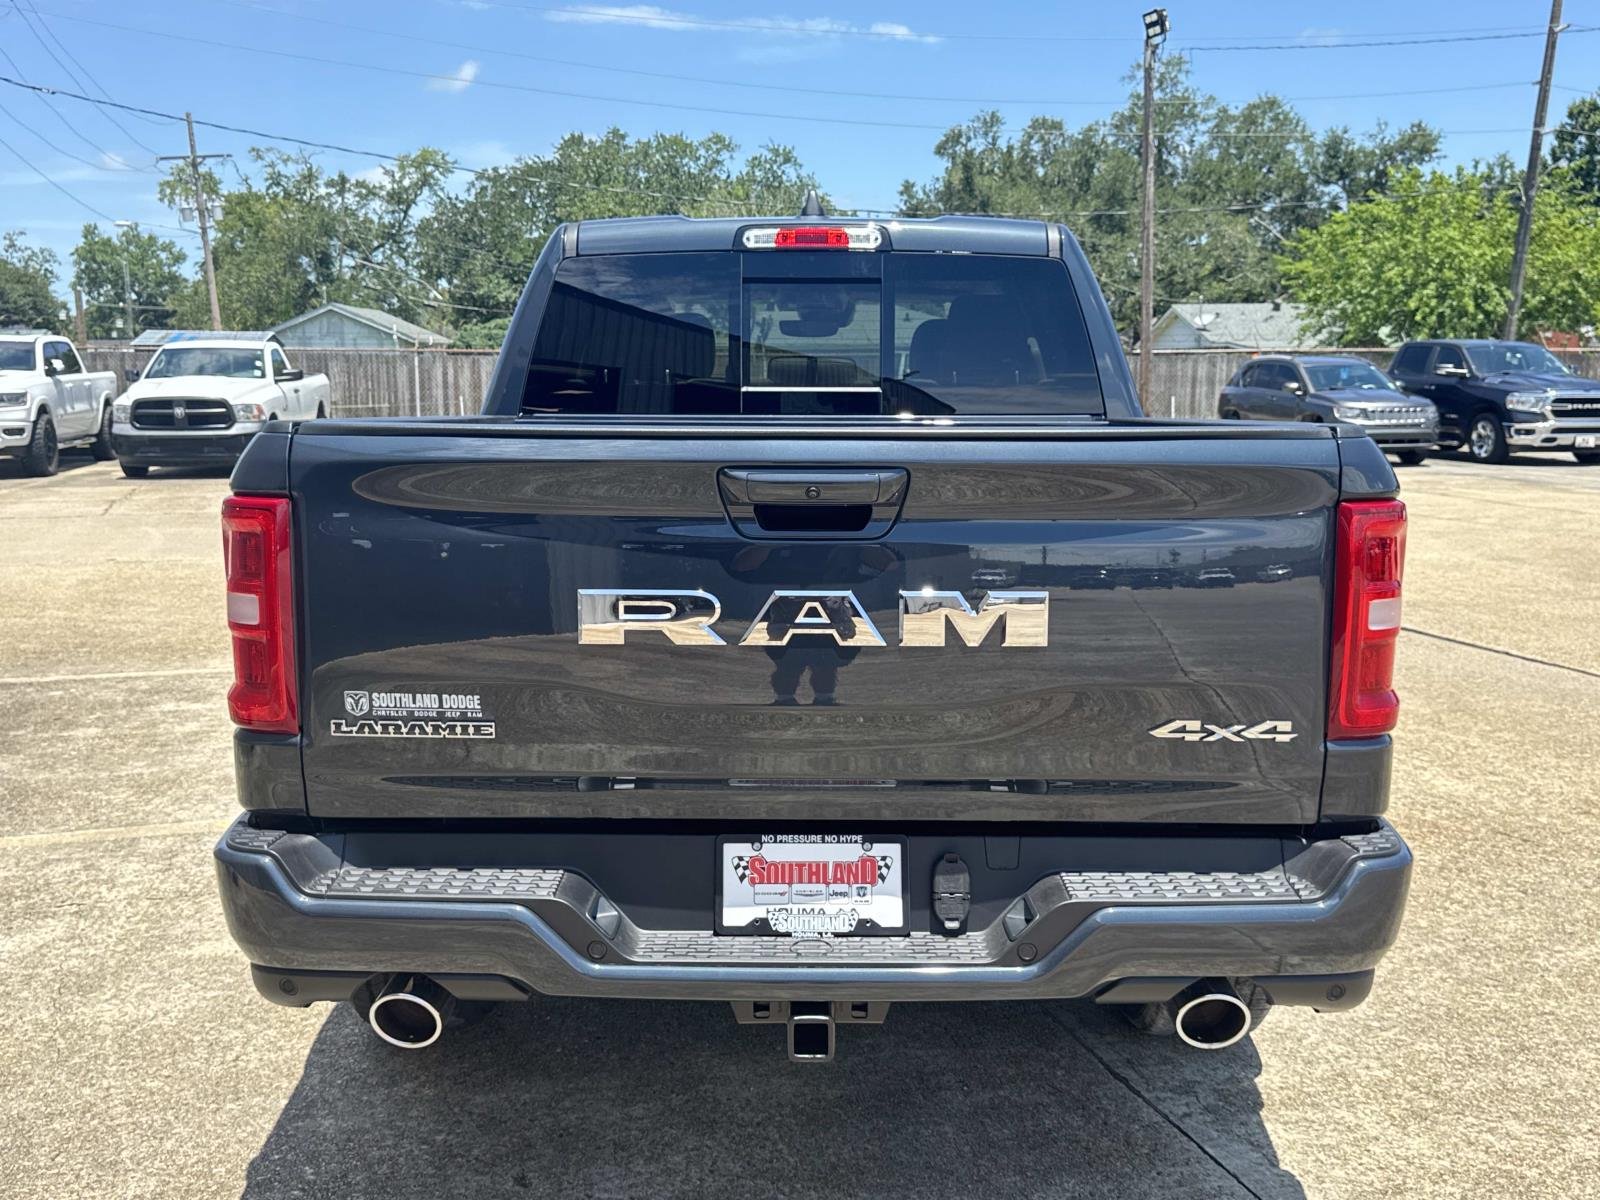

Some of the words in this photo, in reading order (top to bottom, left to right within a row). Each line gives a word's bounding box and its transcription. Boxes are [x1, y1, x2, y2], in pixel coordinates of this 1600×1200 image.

[578, 588, 1049, 648] RAM
[372, 692, 439, 709] SOUTHLAND
[443, 695, 481, 709] DODGE
[331, 719, 496, 739] LARAMIE
[761, 834, 775, 843] NO
[776, 834, 823, 843] PRESSURE
[824, 834, 838, 843] NO
[839, 835, 863, 843] HYPE
[748, 856, 879, 887] SOUTHLAND
[829, 889, 849, 899] Jeep
[777, 913, 850, 932] SOUTHLAND
